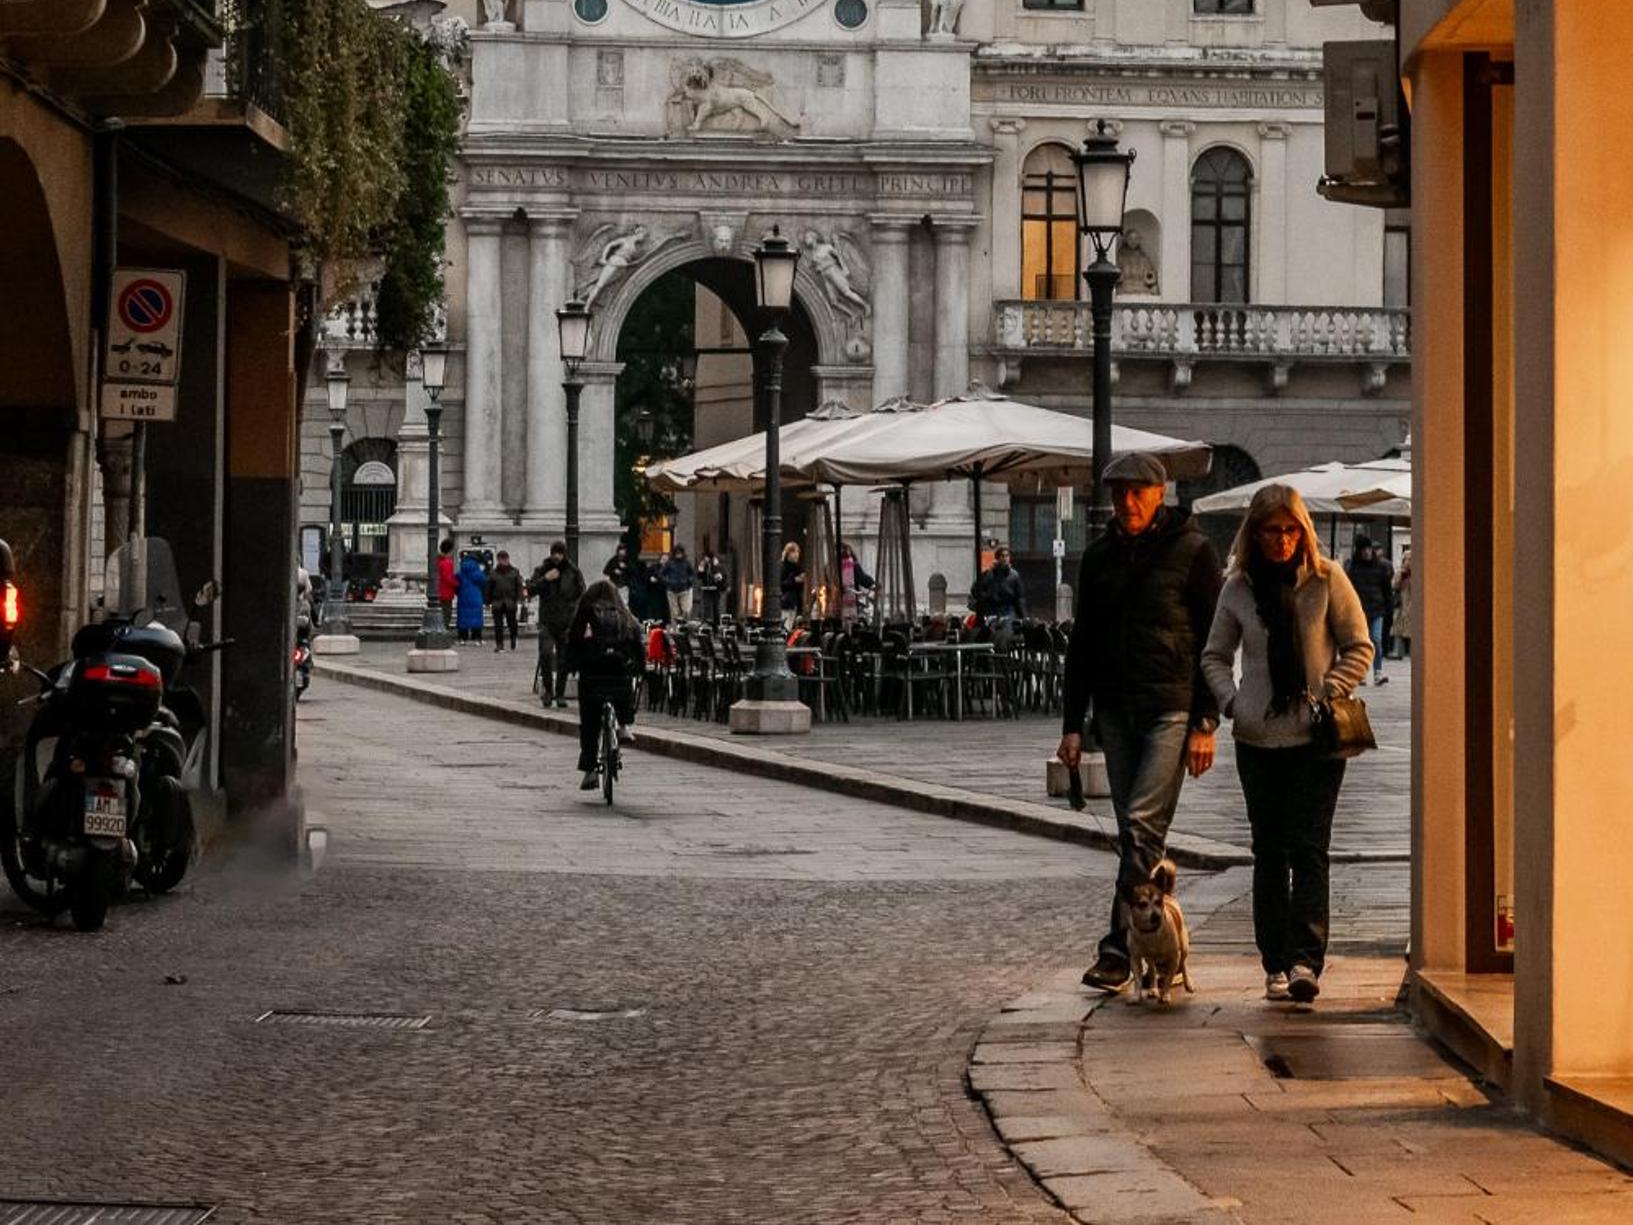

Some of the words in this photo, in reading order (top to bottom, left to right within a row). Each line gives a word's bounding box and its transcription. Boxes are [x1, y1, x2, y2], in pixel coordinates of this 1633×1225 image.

[475, 169, 565, 185] SENATVS
[691, 173, 781, 191] ANDREA
[880, 174, 969, 193] PRINCIPE
[120, 388, 158, 400] ambo
[131, 404, 156, 416] lati
[86, 816, 125, 833] 99920
